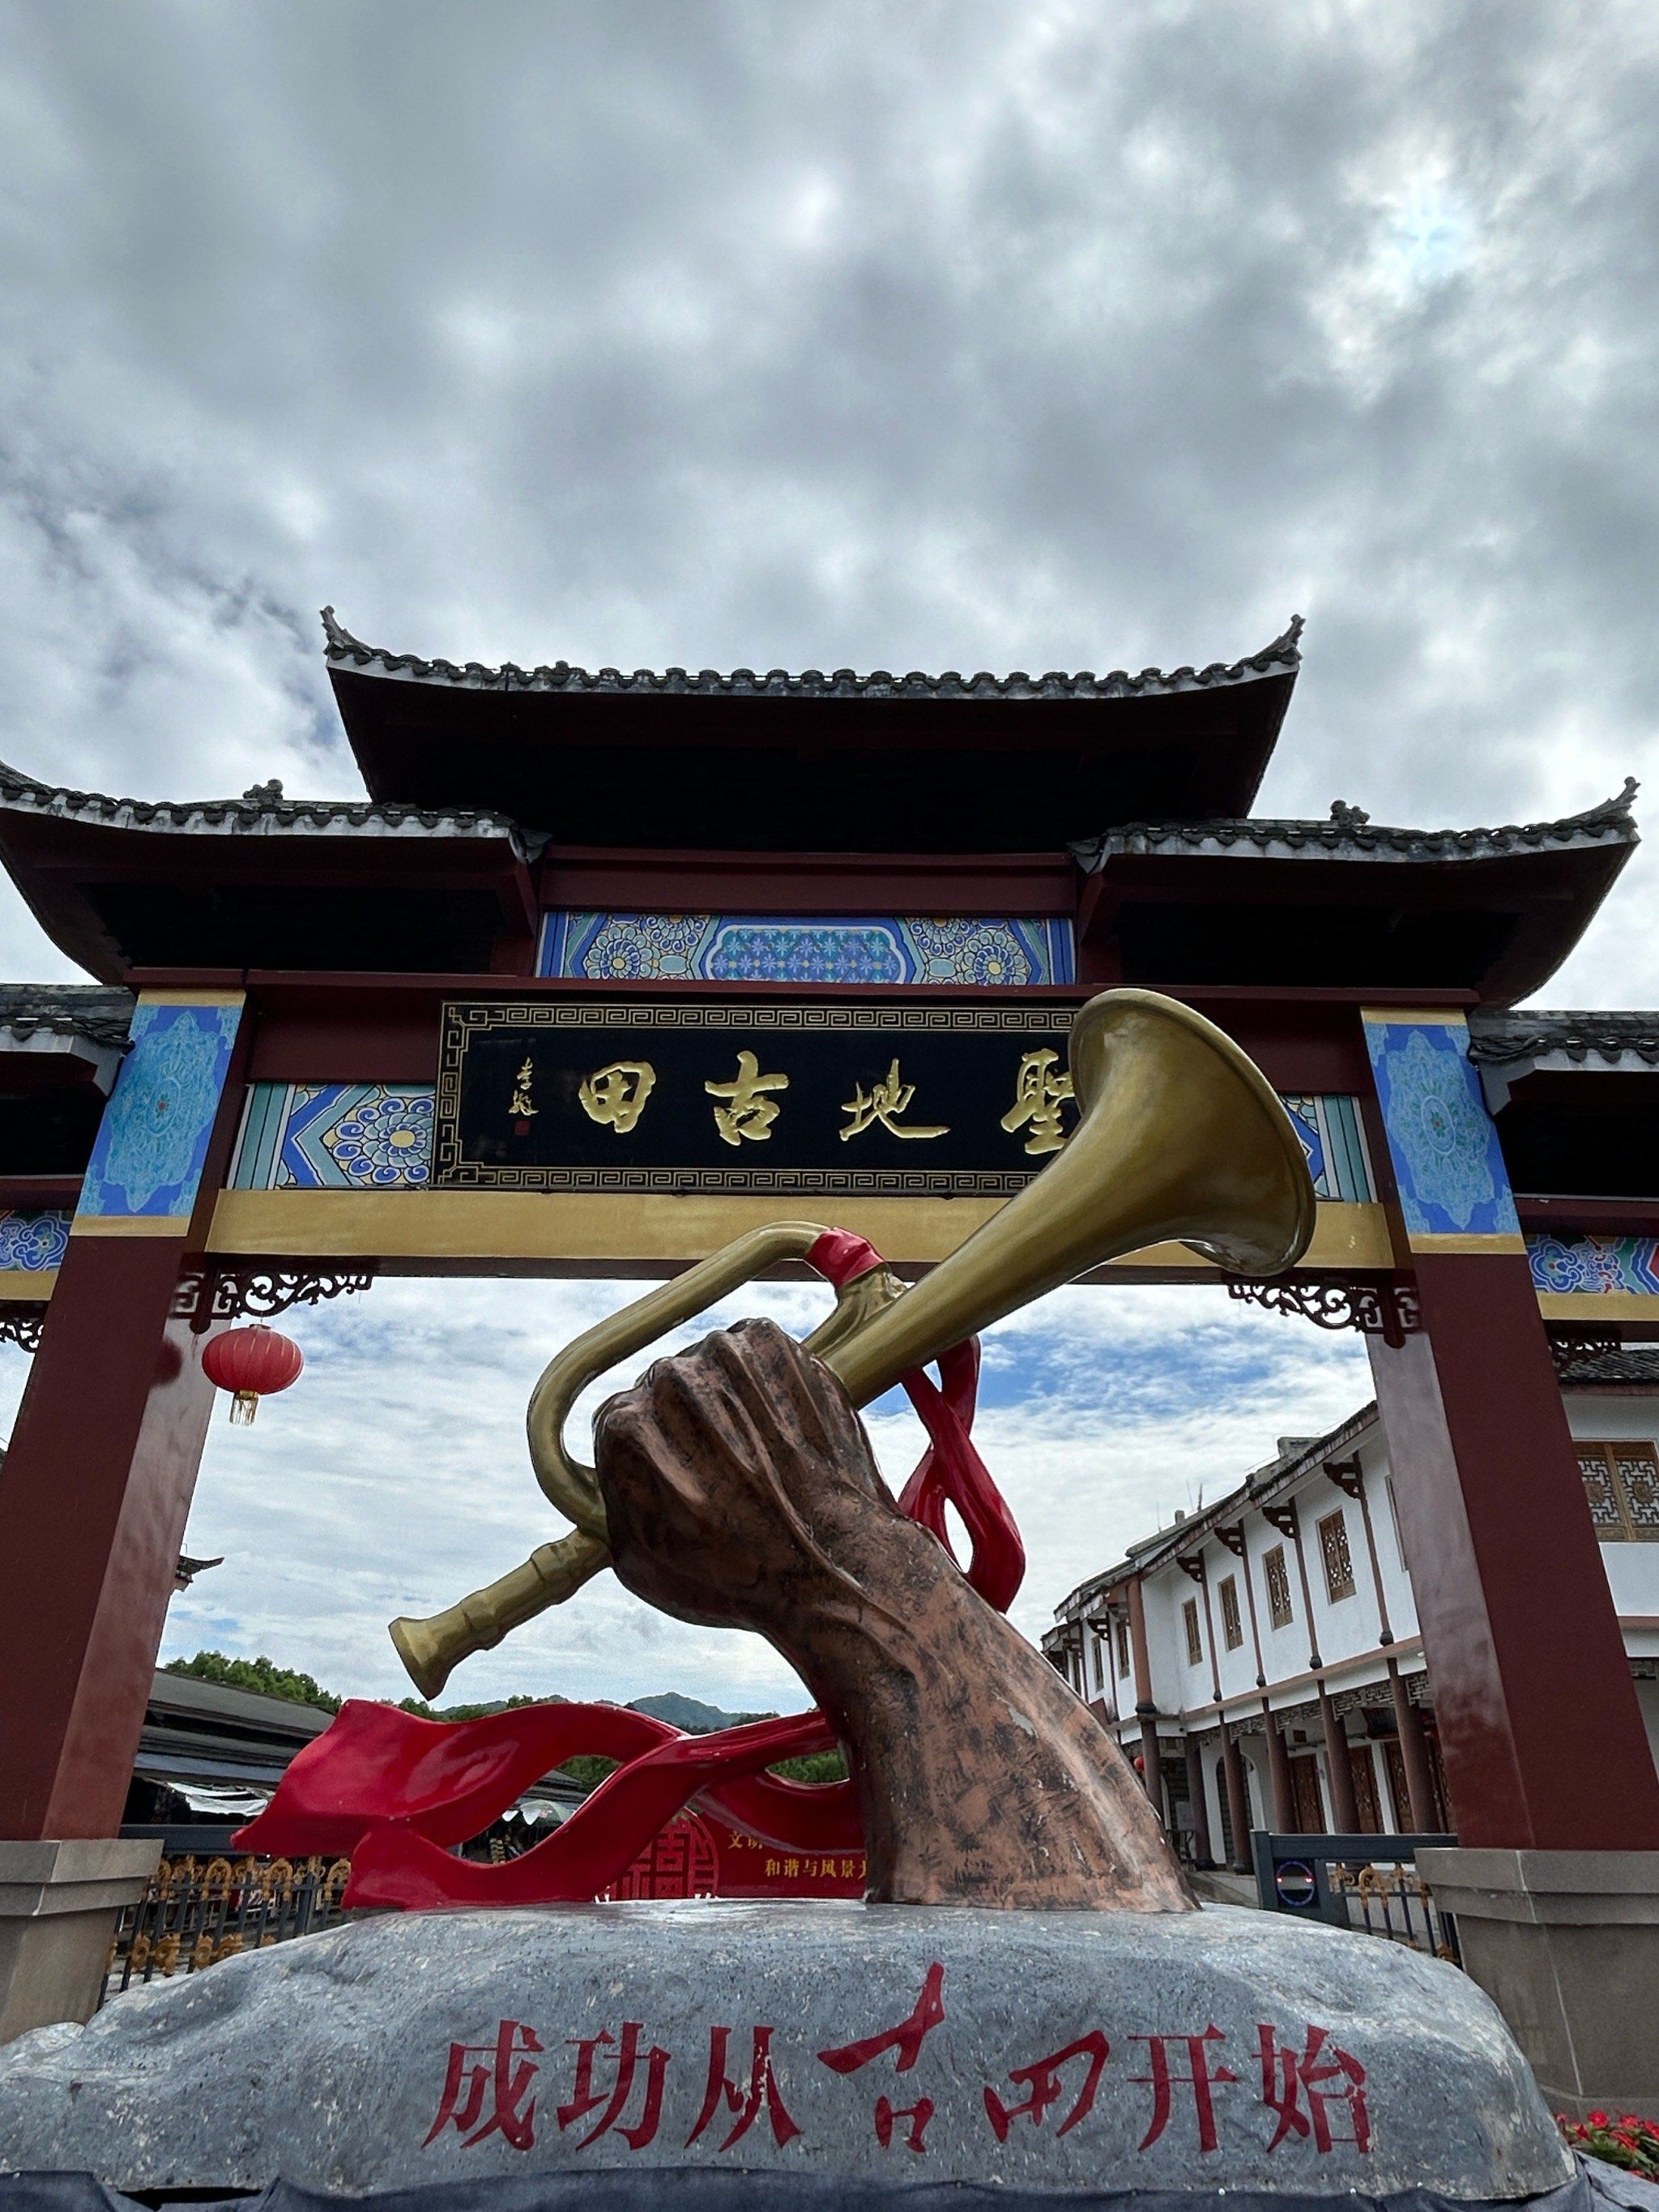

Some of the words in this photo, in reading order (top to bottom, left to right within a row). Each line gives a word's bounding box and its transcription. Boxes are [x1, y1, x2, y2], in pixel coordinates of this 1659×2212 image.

[420, 1962, 1372, 2154] 成功从古田开始
